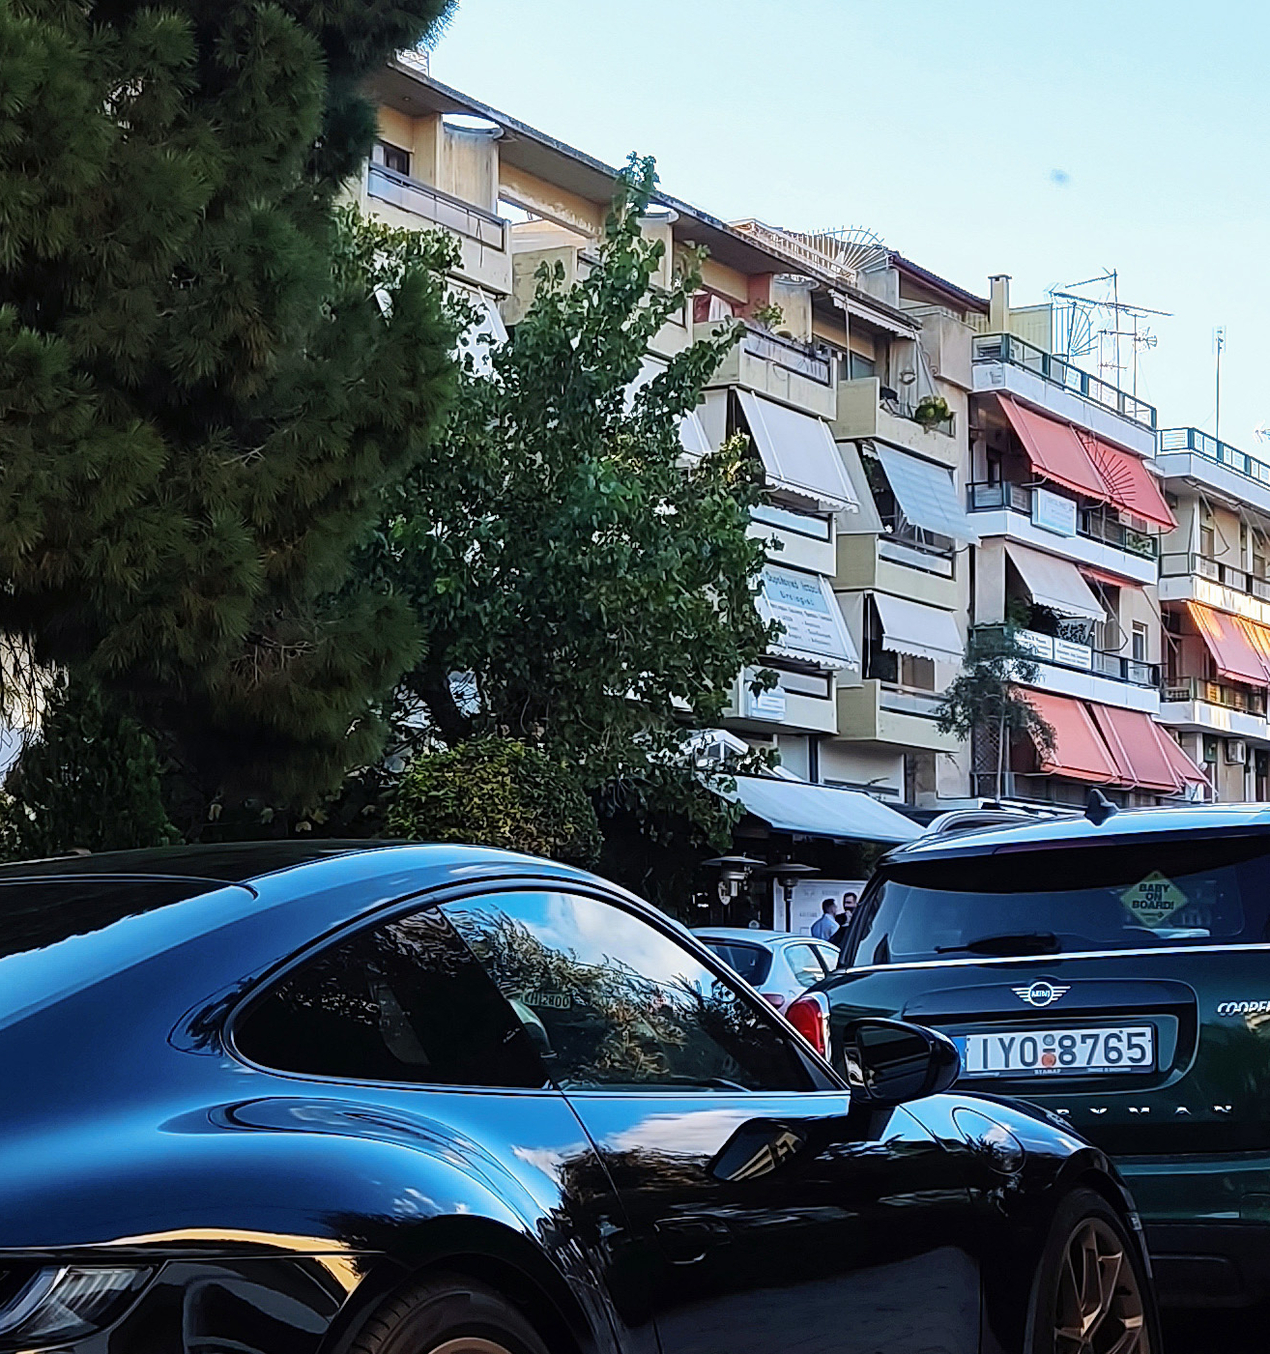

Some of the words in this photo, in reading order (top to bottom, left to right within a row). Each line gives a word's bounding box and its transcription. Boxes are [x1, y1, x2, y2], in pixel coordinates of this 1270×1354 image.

[1139, 883, 1170, 892] BABY
[1146, 893, 1163, 901] ON
[1132, 900, 1175, 909] BOARD!
